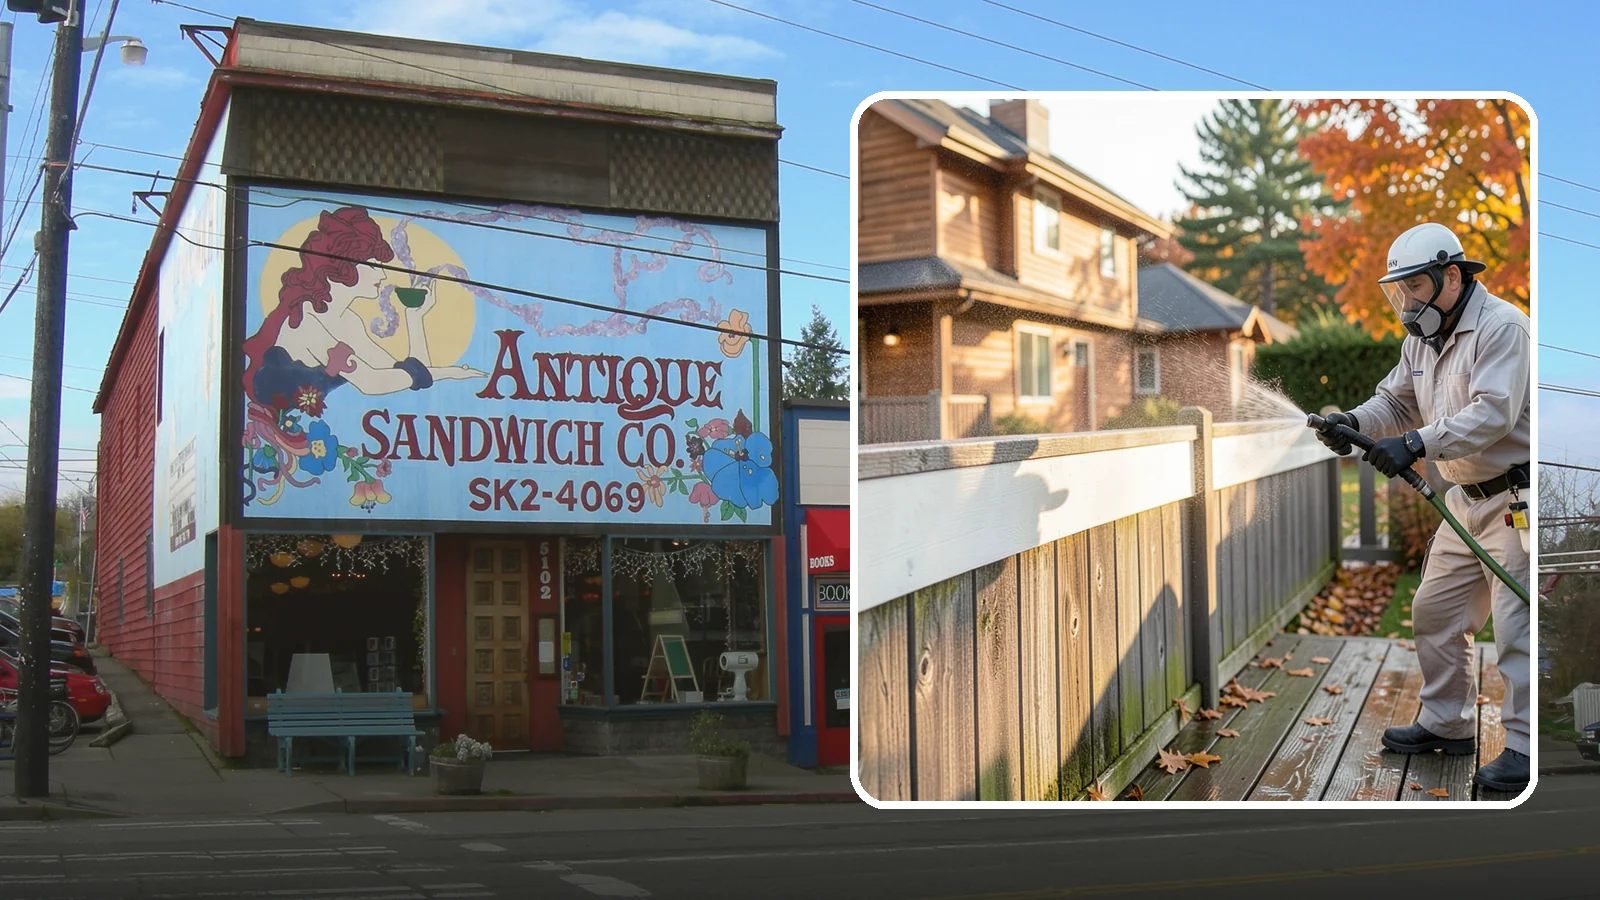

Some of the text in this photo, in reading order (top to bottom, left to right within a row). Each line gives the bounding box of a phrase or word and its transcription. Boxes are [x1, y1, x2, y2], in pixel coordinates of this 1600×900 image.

[476, 329, 723, 421] ANTIQUE
[361, 408, 685, 469] SANDWICH CO.
[468, 477, 646, 513] SK2-4069
[540, 541, 552, 600] 5102
[809, 555, 835, 569] BOOKS
